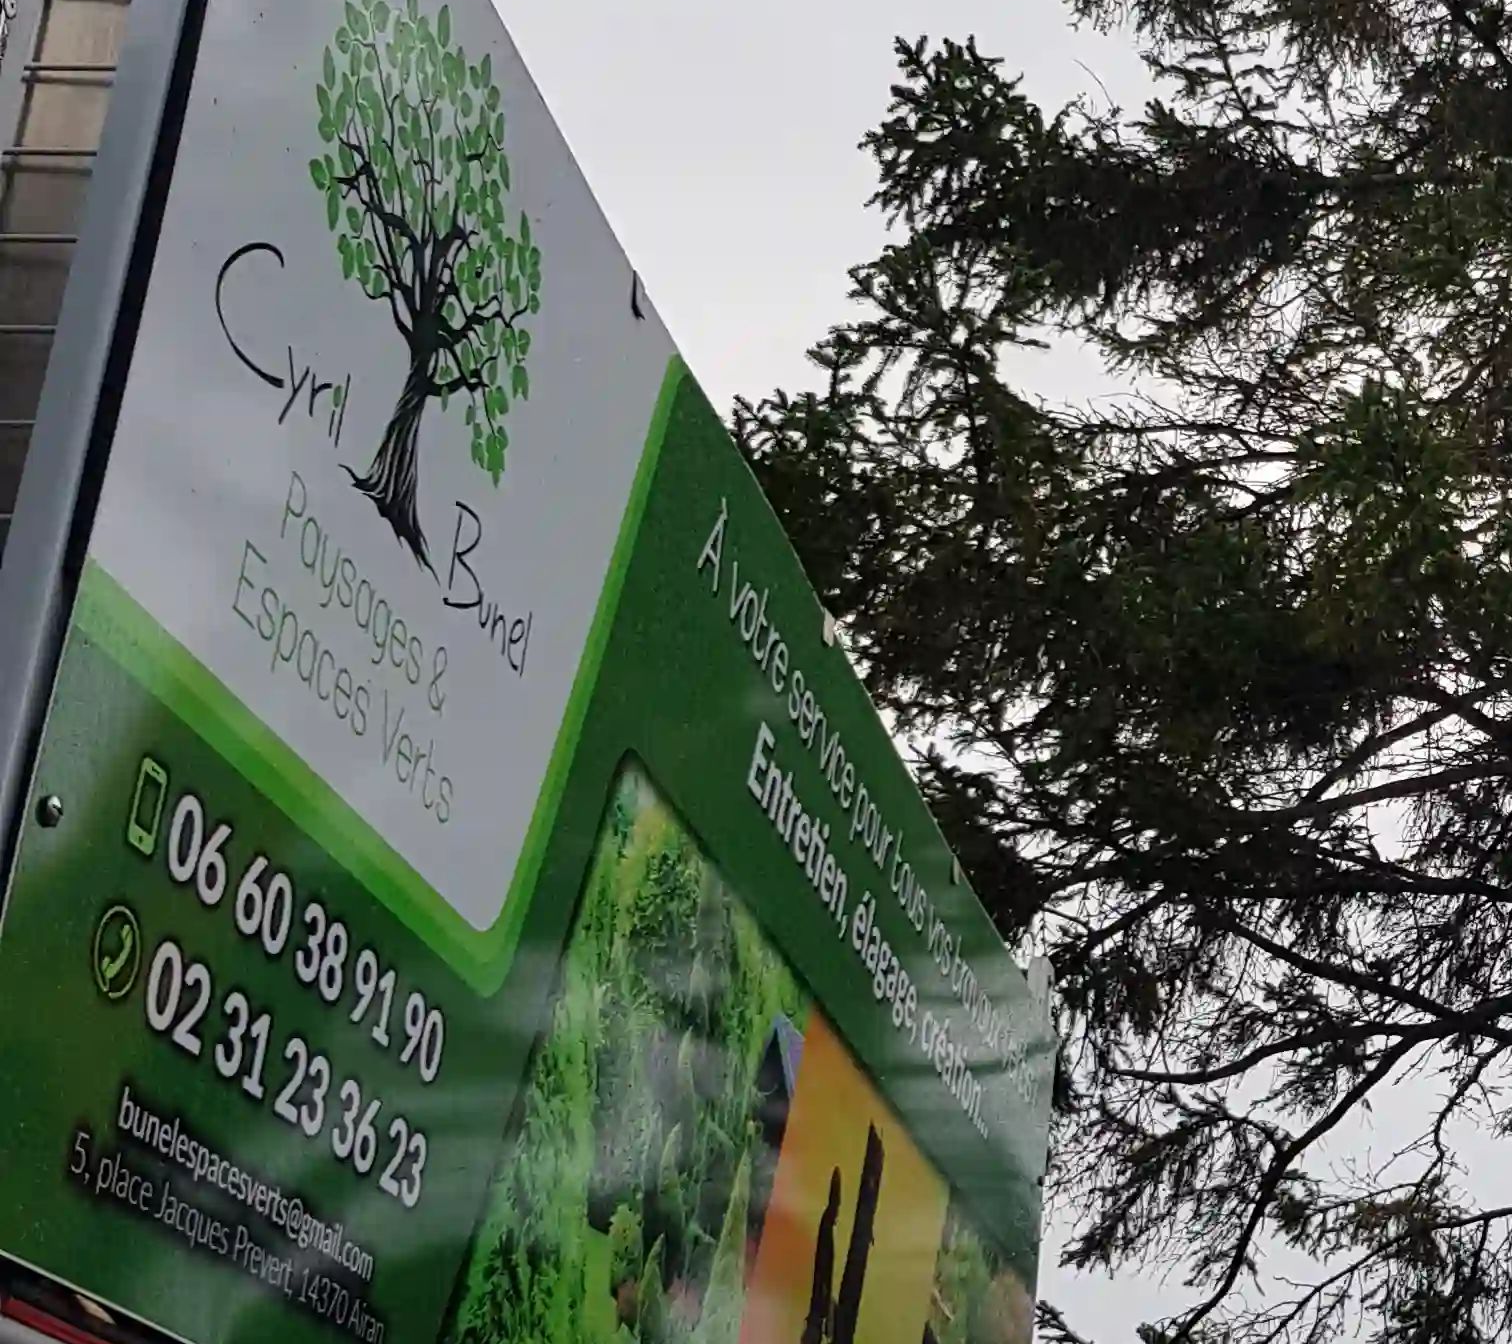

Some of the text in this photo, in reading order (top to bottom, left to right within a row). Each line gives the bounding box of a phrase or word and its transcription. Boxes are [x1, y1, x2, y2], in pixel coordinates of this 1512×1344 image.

[215, 242, 350, 448] Cyril
[232, 539, 453, 824] Espaces Verts
[280, 471, 449, 717] Paysages &
[442, 501, 533, 677] Bunel
[730, 560, 790, 693] votre
[789, 669, 855, 808] service
[849, 782, 894, 869] pour
[890, 829, 928, 932] tous
[928, 904, 953, 976] vos
[747, 720, 848, 940] Entretien,
[852, 890, 918, 1045] élagage,
[169, 795, 444, 1082] 06 60 38 91 90
[118, 1086, 375, 1281] bunelespacesverts@gmail.com
[147, 941, 427, 1207] 02 31 23 36 23
[70, 1132, 91, 1184] 5,
[95, 1153, 153, 1211] place
[154, 1182, 230, 1255] Jacques
[298, 1267, 349, 1325] 14370
